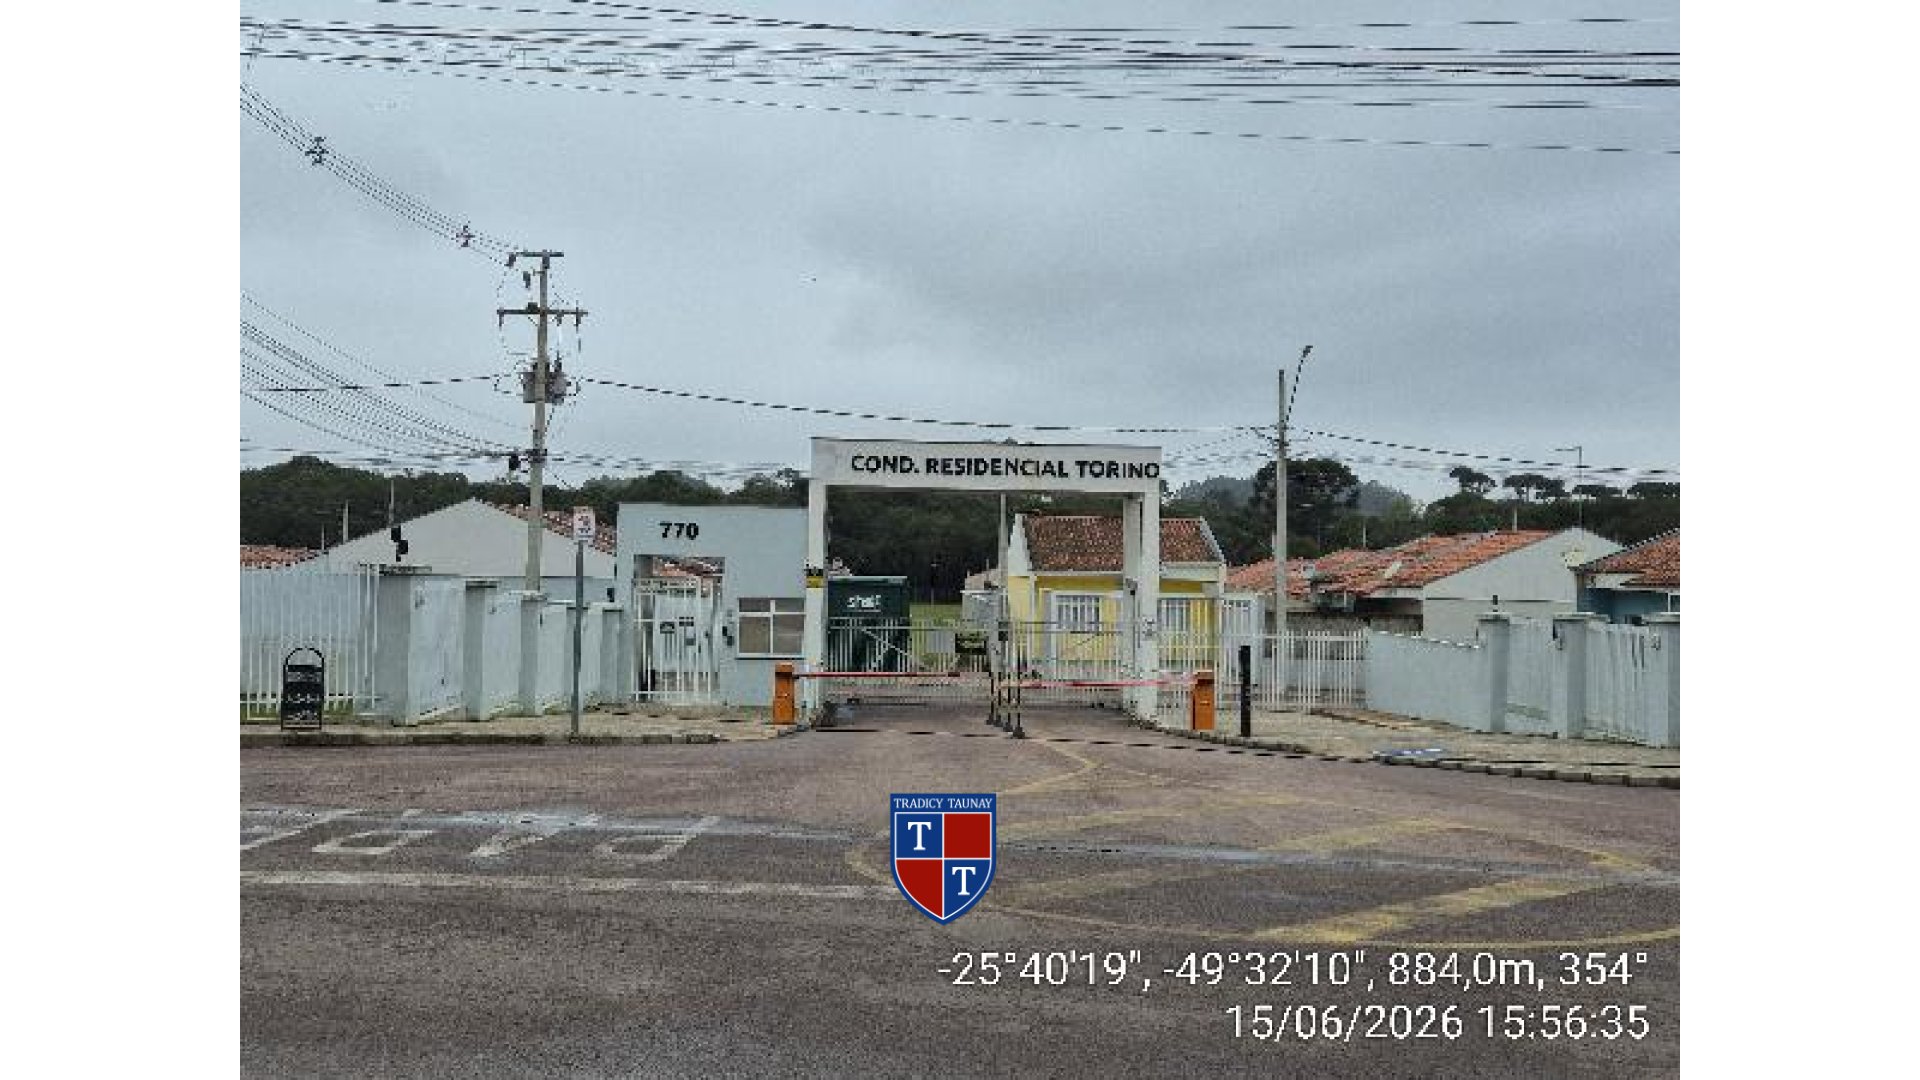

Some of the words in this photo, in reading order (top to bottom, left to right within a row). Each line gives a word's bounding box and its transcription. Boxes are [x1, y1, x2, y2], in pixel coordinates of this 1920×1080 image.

[850, 455, 920, 474] COND.
[925, 457, 1069, 478] RESIDENCIAL
[1074, 460, 1161, 479] TORINO
[658, 521, 700, 541] 770
